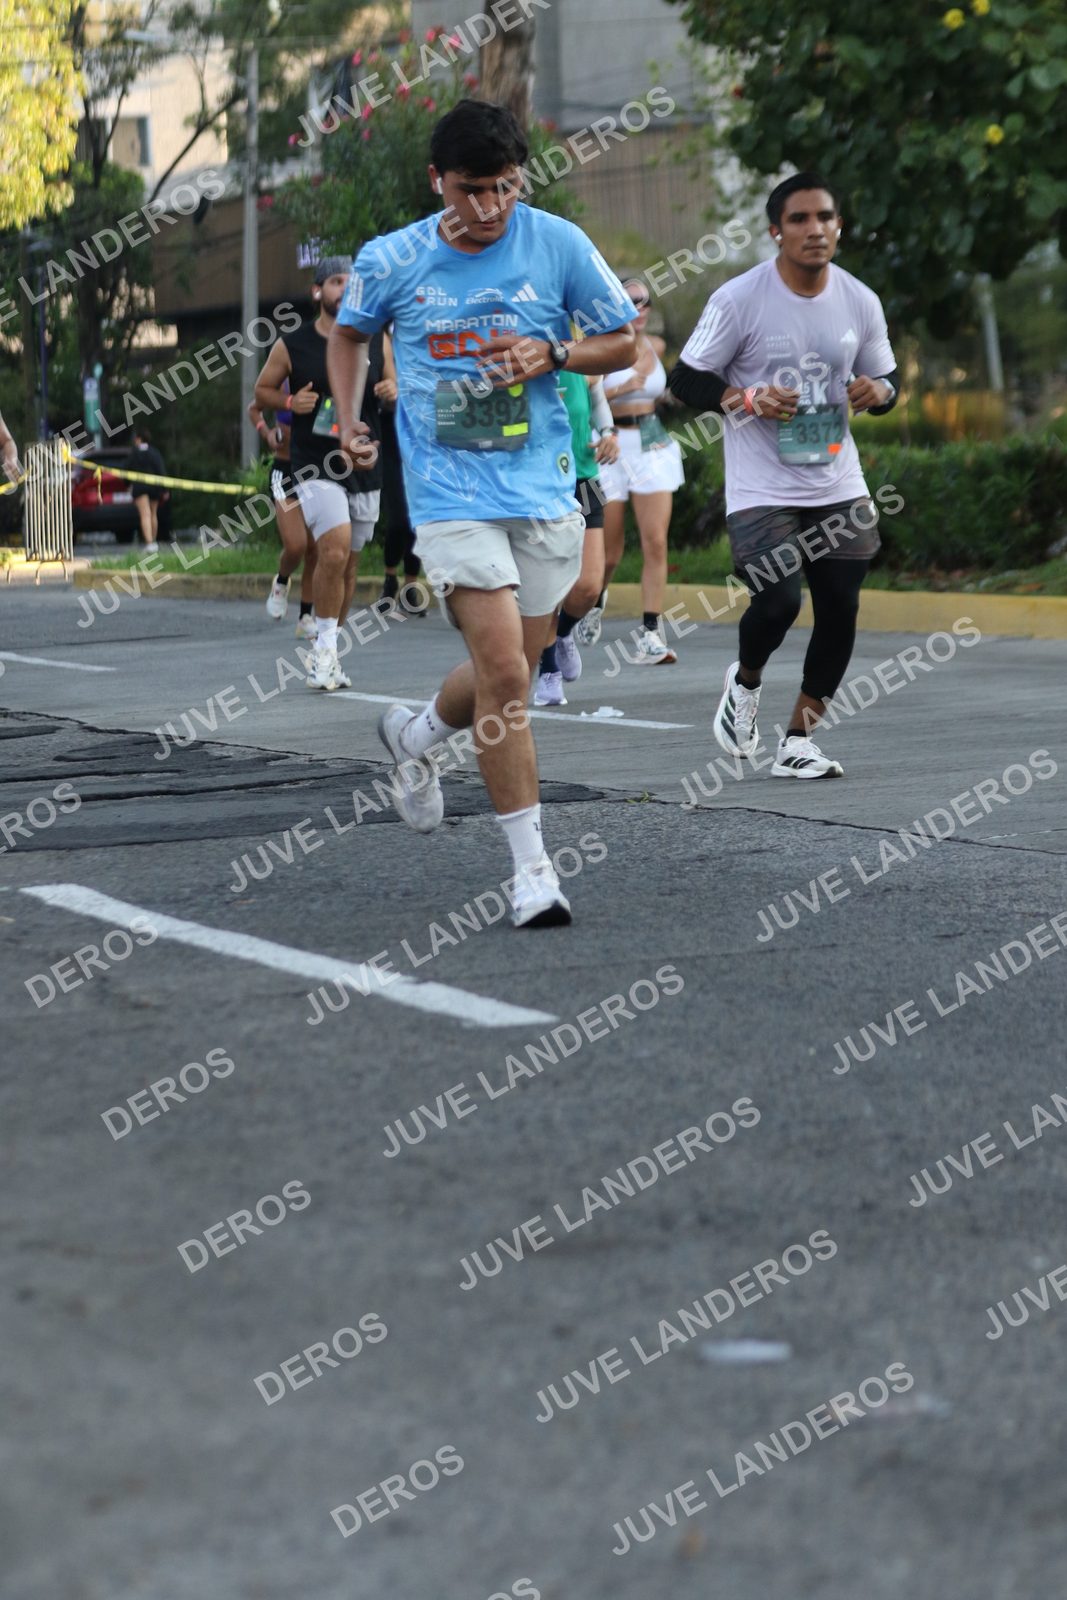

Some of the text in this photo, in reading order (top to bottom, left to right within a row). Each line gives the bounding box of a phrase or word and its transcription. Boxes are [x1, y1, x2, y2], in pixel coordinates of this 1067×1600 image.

[416, 287, 447, 296] GDL
[427, 296, 458, 306] RUN
[461, 397, 527, 428] 3392
